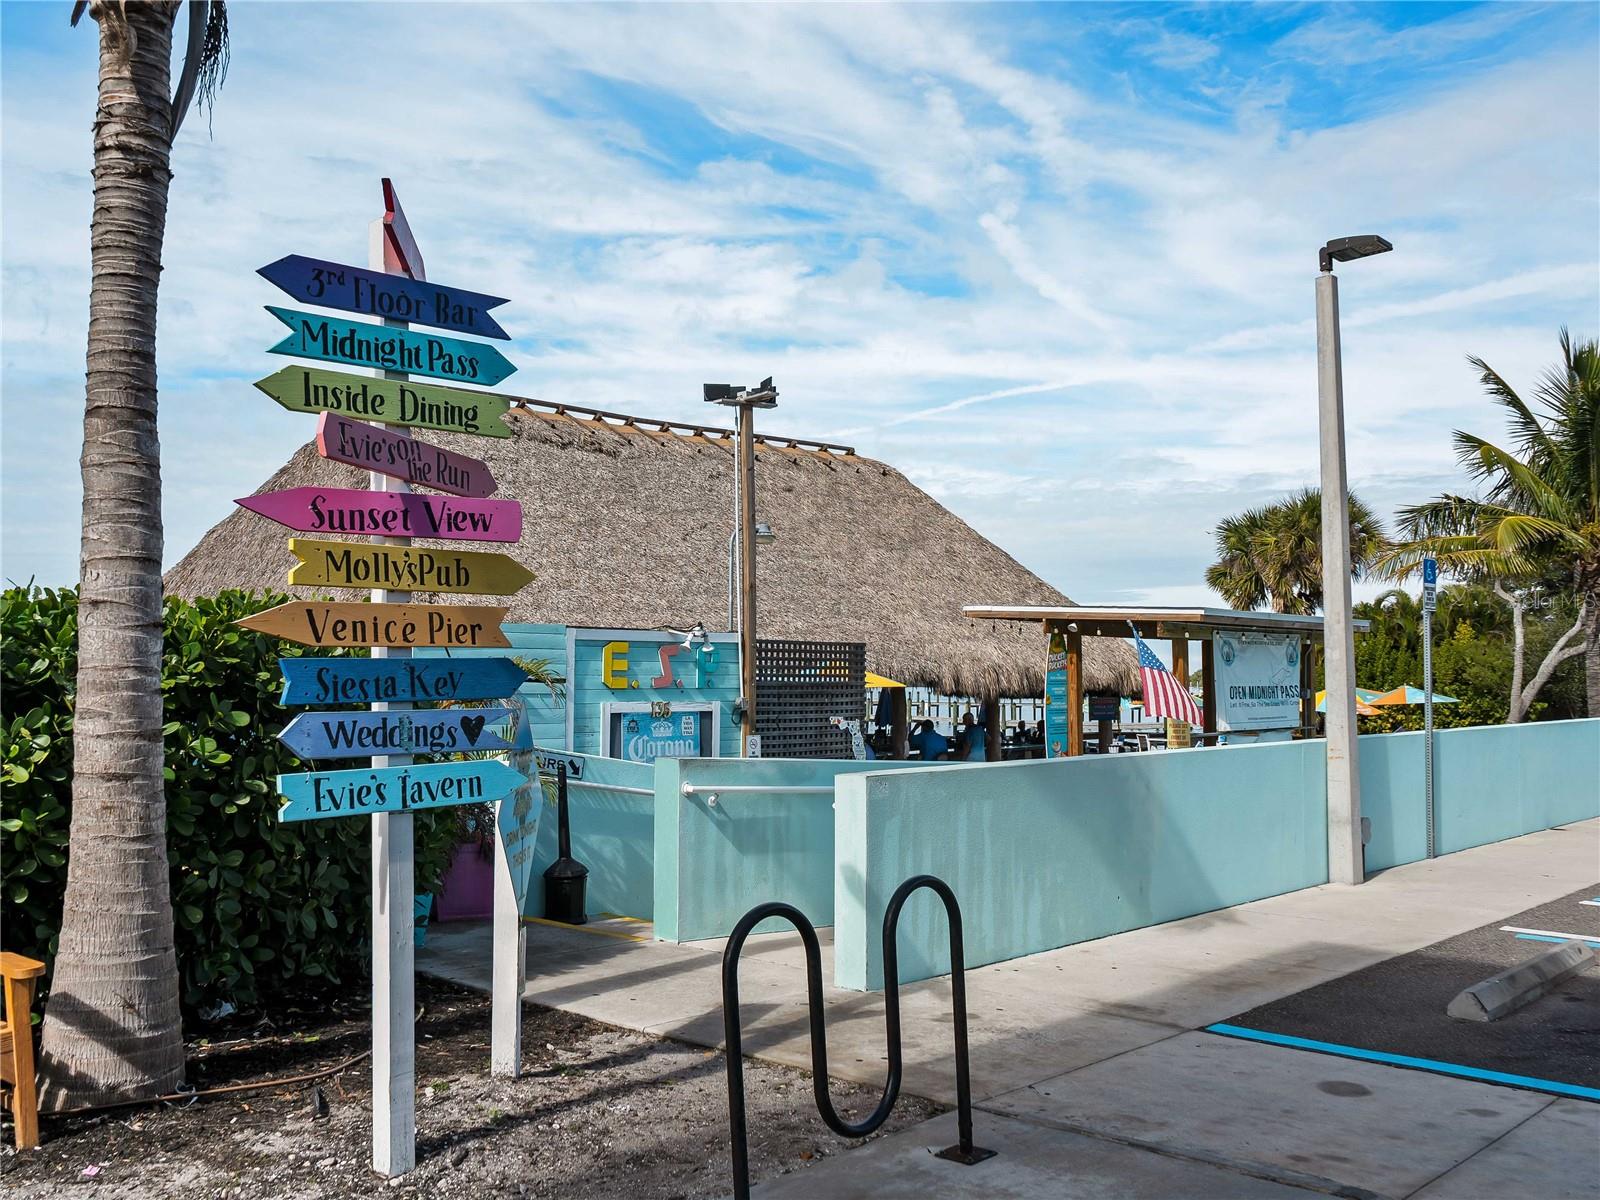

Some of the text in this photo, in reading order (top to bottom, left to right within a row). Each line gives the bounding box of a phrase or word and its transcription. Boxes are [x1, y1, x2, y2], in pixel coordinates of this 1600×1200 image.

[306, 267, 478, 327] 3rd Floor Bar
[301, 319, 480, 379] Midnight Pass
[303, 371, 480, 433] Inside Dining
[337, 421, 422, 464] Evie's on
[407, 453, 471, 492] the Run
[308, 494, 494, 533] Sunset View
[305, 608, 482, 645] Venice Pier
[316, 664, 464, 703] Siesta Key
[1229, 684, 1300, 700] OPEN MIDNIGHT PASS
[322, 716, 458, 752] Weddings
[628, 735, 694, 761] Corona
[313, 773, 482, 813] Evie's Tavern
